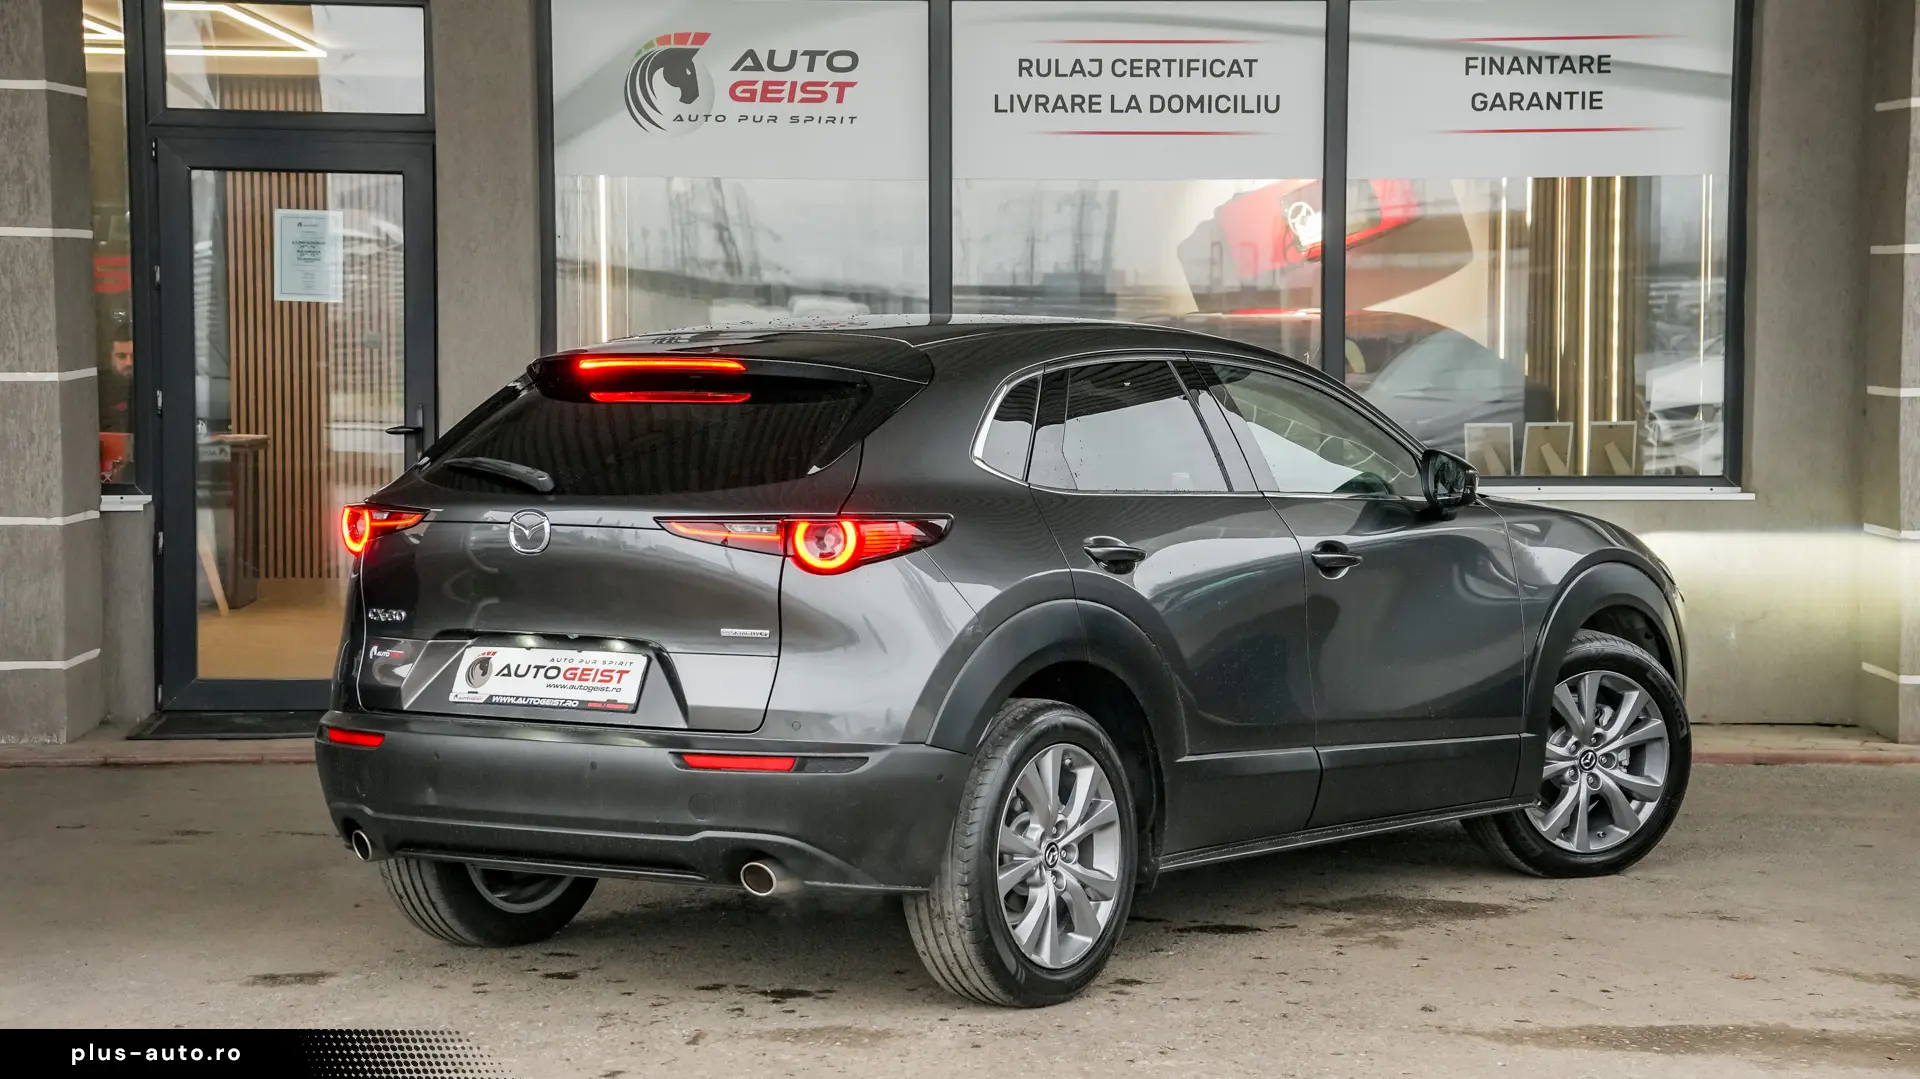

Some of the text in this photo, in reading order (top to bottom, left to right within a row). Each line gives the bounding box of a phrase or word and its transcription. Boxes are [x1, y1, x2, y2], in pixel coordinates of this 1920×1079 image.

[729, 49, 859, 73] AUTO
[1018, 58, 1258, 78] RULAJ CERTIFICAT
[1464, 54, 1612, 76] FINANTARE
[728, 80, 858, 104] GEIST
[1471, 91, 1604, 112] GARANTIE
[994, 94, 1281, 114] LIVRARE LA DOMICILIU
[672, 113, 858, 125] AUTO PUR SPIRIT
[545, 682, 622, 693] www.autogeist.ro
[491, 695, 579, 707] WWW.AUTOGEIST.RO
